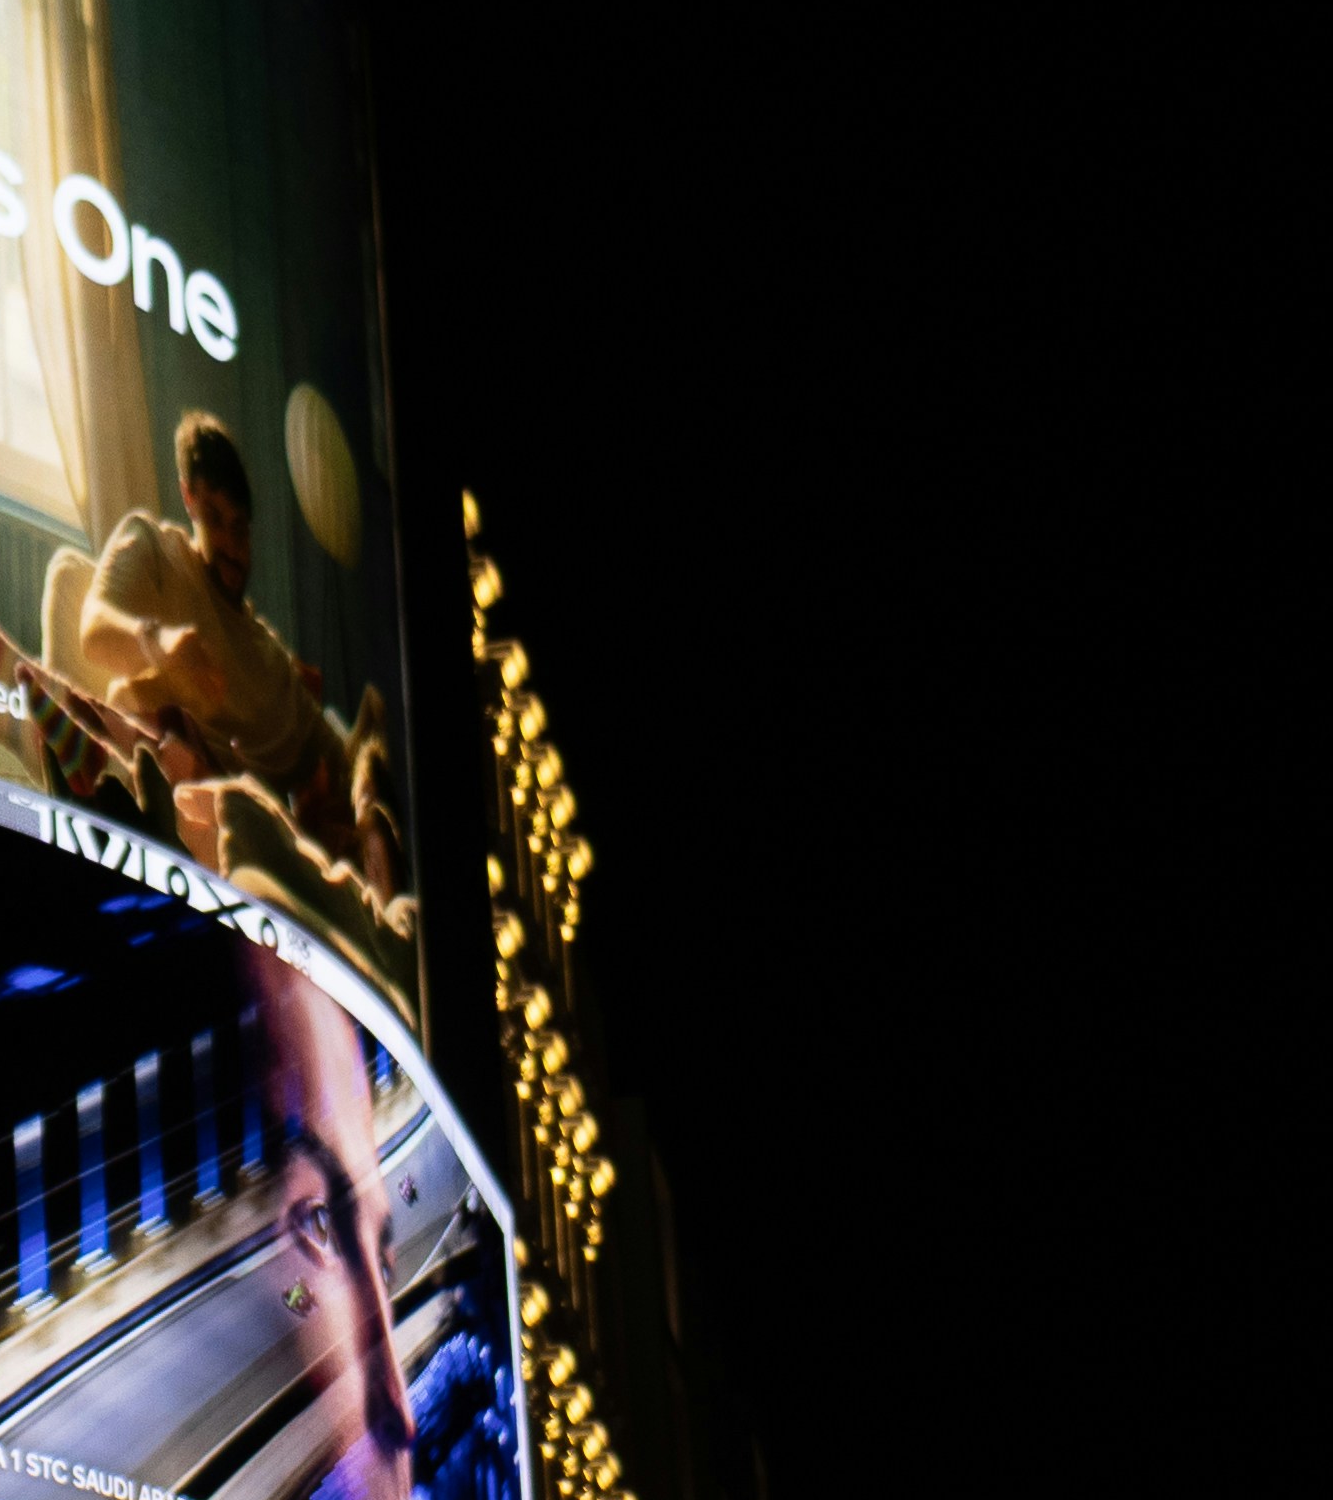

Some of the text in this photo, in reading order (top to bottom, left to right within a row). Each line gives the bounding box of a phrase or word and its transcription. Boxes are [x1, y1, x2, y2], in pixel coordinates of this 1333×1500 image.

[53, 174, 238, 362] One
[10, 1449, 22, 1473] 1
[26, 1453, 69, 1485] STC
